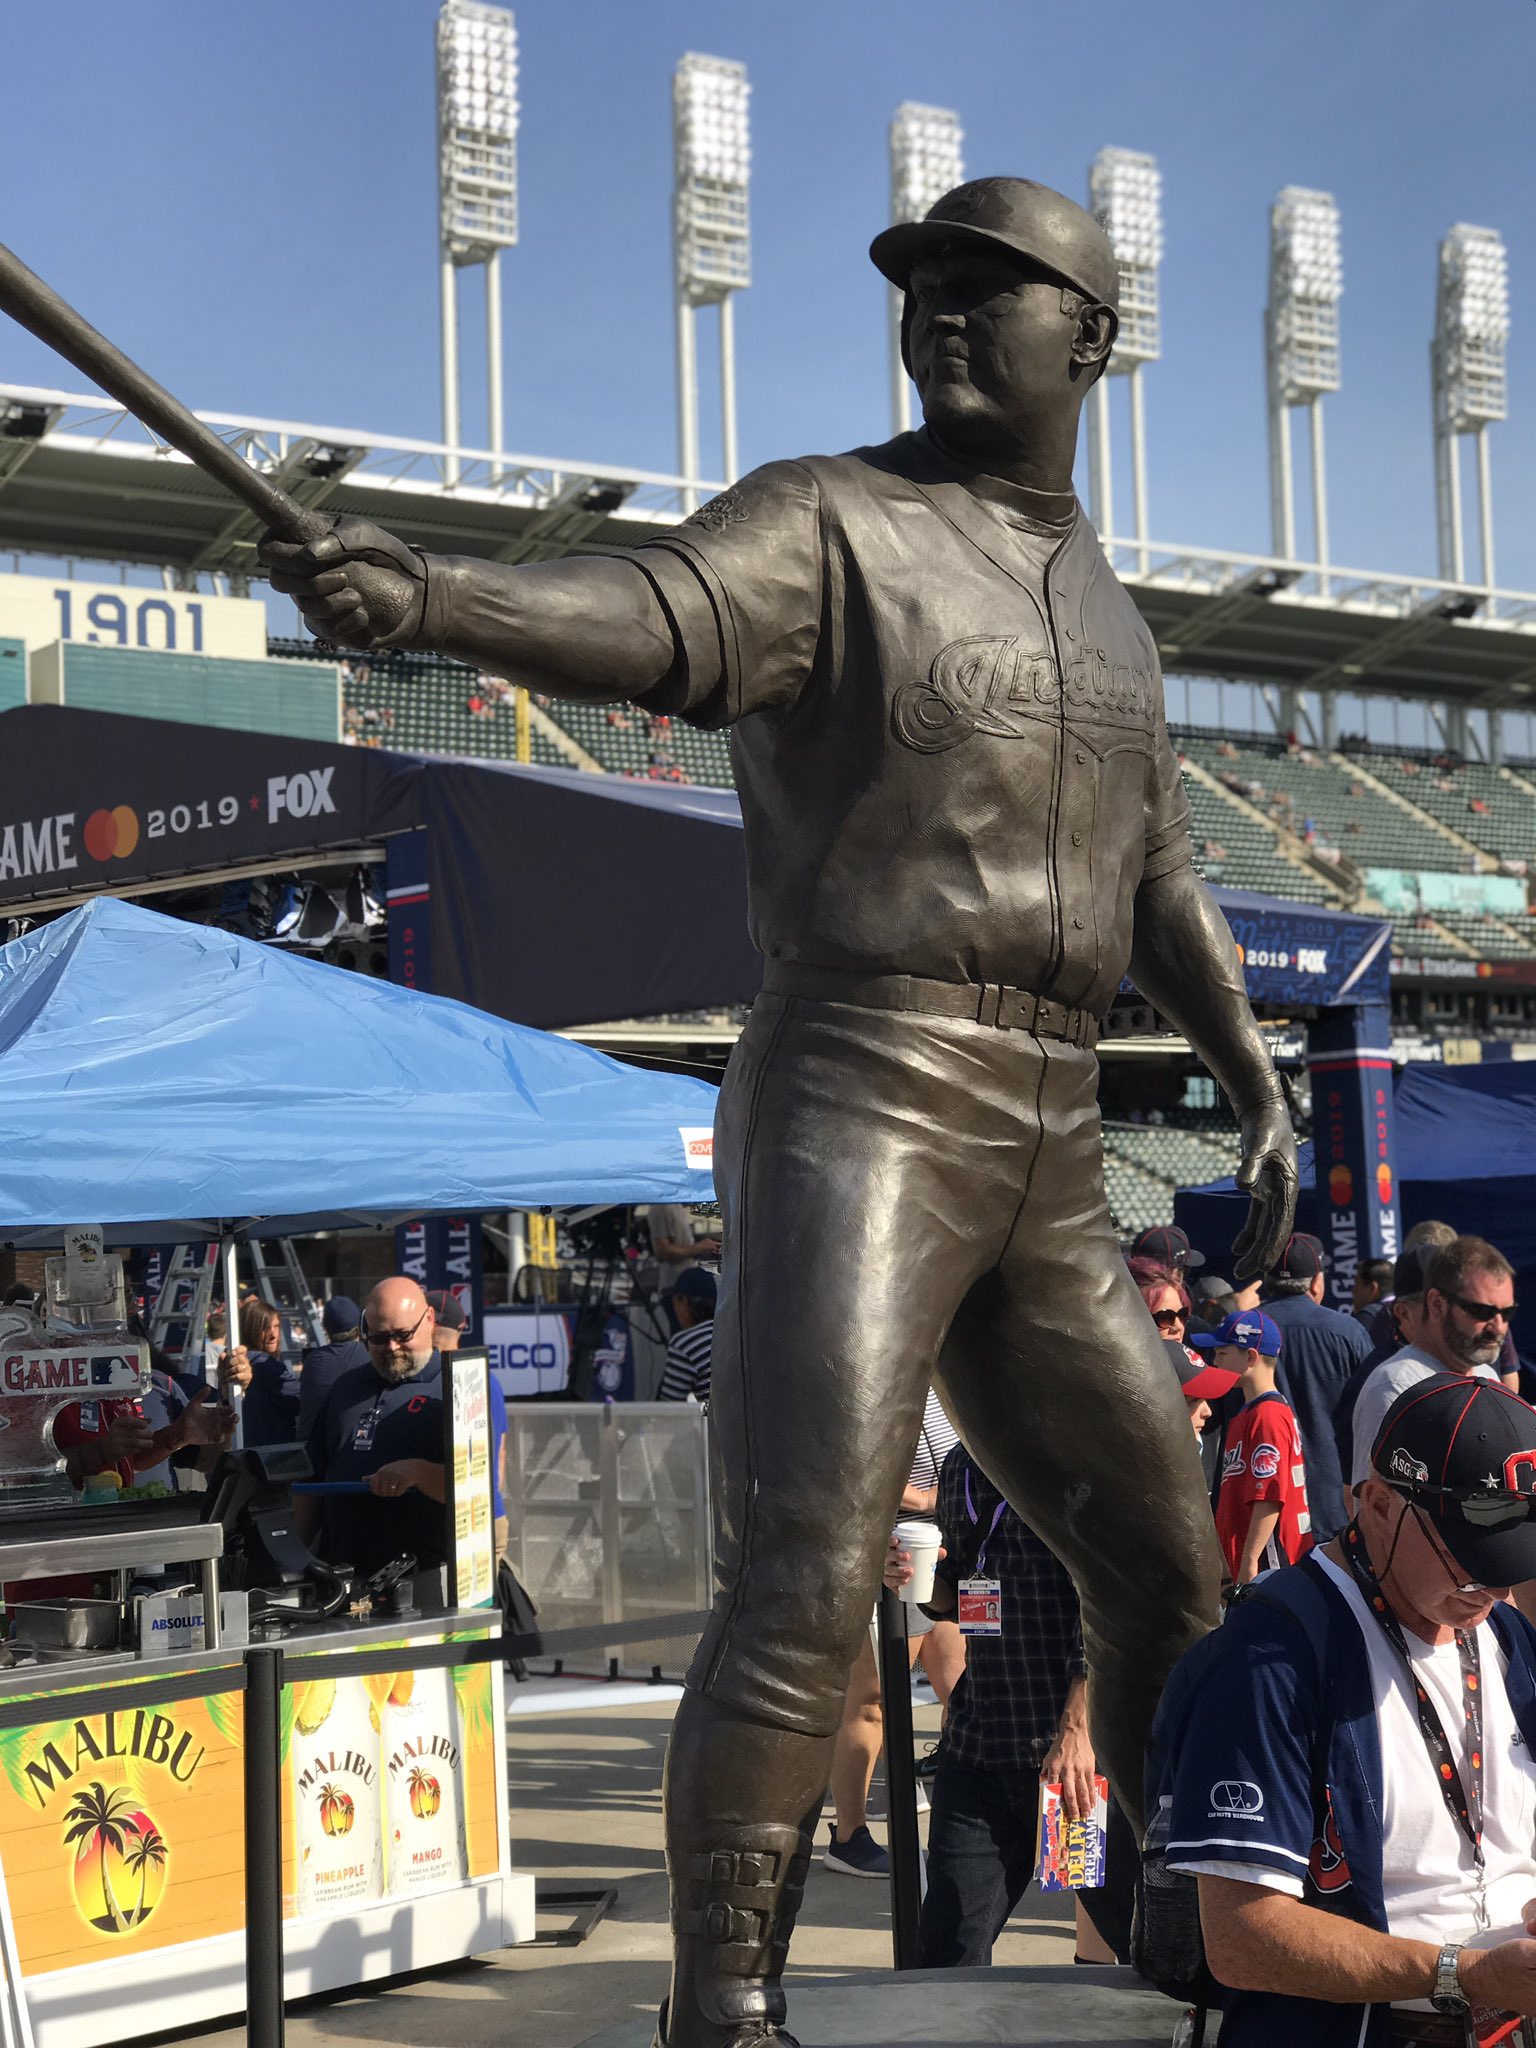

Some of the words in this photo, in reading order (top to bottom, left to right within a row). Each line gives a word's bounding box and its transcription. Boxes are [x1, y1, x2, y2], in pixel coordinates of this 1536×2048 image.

[54, 589, 203, 651] 1901
[147, 796, 240, 838] 2019
[267, 766, 337, 824] FOX
[1246, 950, 1289, 968] 2019
[1297, 948, 1328, 974] FOX
[1376, 1089, 1388, 1158] 2019
[146, 1252, 161, 1291] ALL
[403, 1223, 427, 1279] ALL
[446, 1222, 471, 1279] ALL
[1331, 1211, 1359, 1299] GAME
[4, 1355, 89, 1392] GAME
[407, 1395, 427, 1414] C
[1392, 1456, 1411, 1478] ASG
[24, 1710, 205, 1808] MALIBU
[298, 1750, 376, 1798] MALIBU
[388, 1735, 460, 1782] MALIBU
[315, 1864, 365, 1885] PINEAPPLE
[412, 1847, 442, 1865] MANGO
